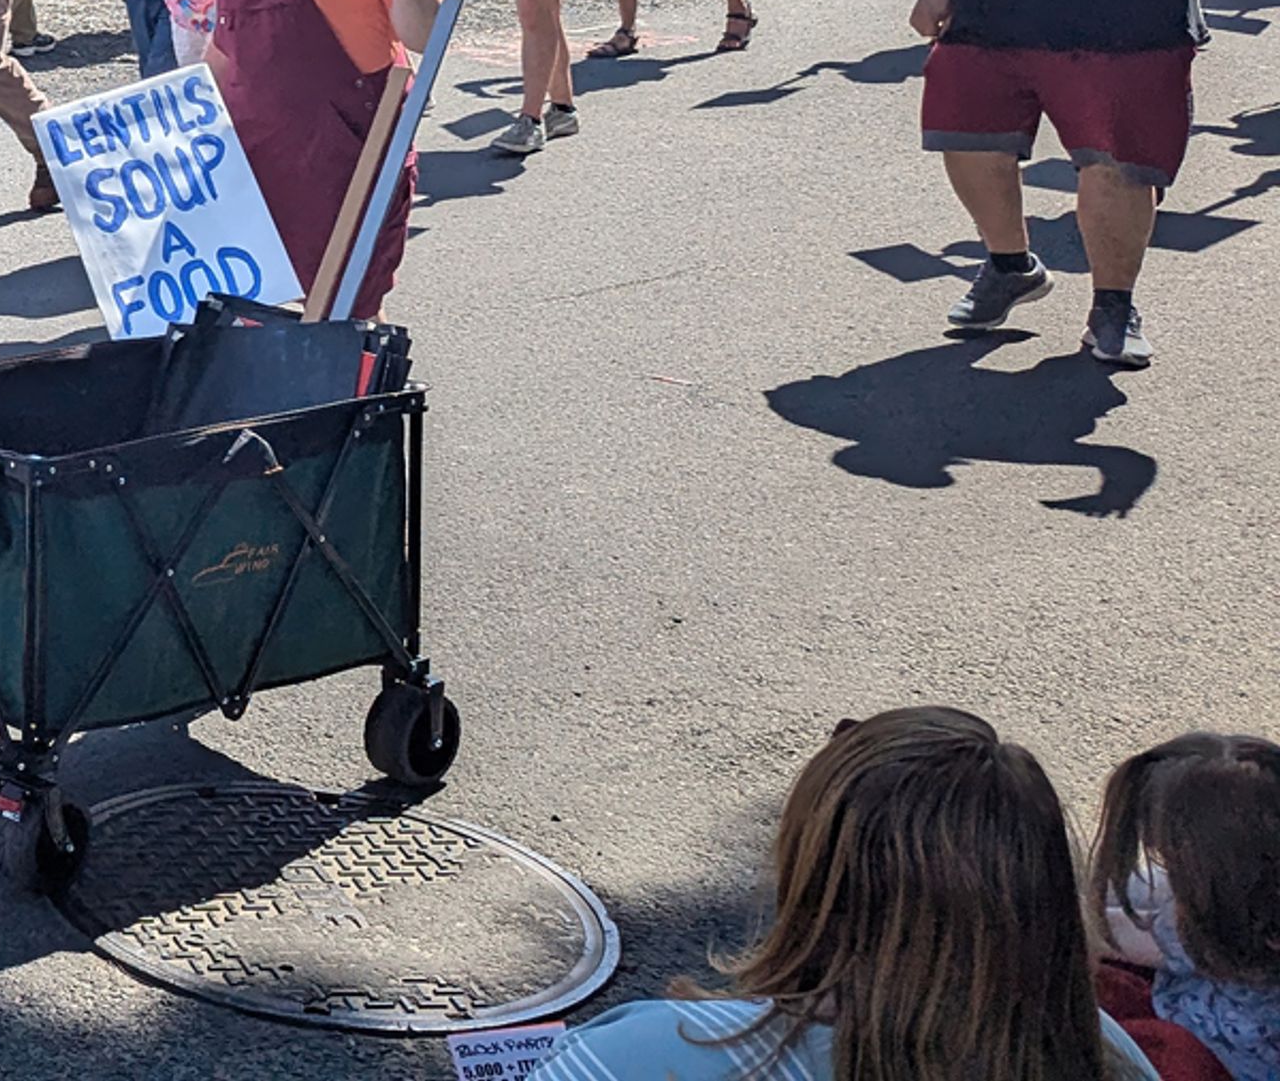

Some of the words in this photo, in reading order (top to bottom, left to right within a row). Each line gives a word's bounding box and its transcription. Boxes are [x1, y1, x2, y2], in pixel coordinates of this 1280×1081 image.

[85, 134, 226, 233] SOUP
[162, 221, 196, 264] A
[112, 246, 262, 335] FOOD
[455, 1040, 504, 1059] BLOCK
[504, 1036, 555, 1052] PARTY
